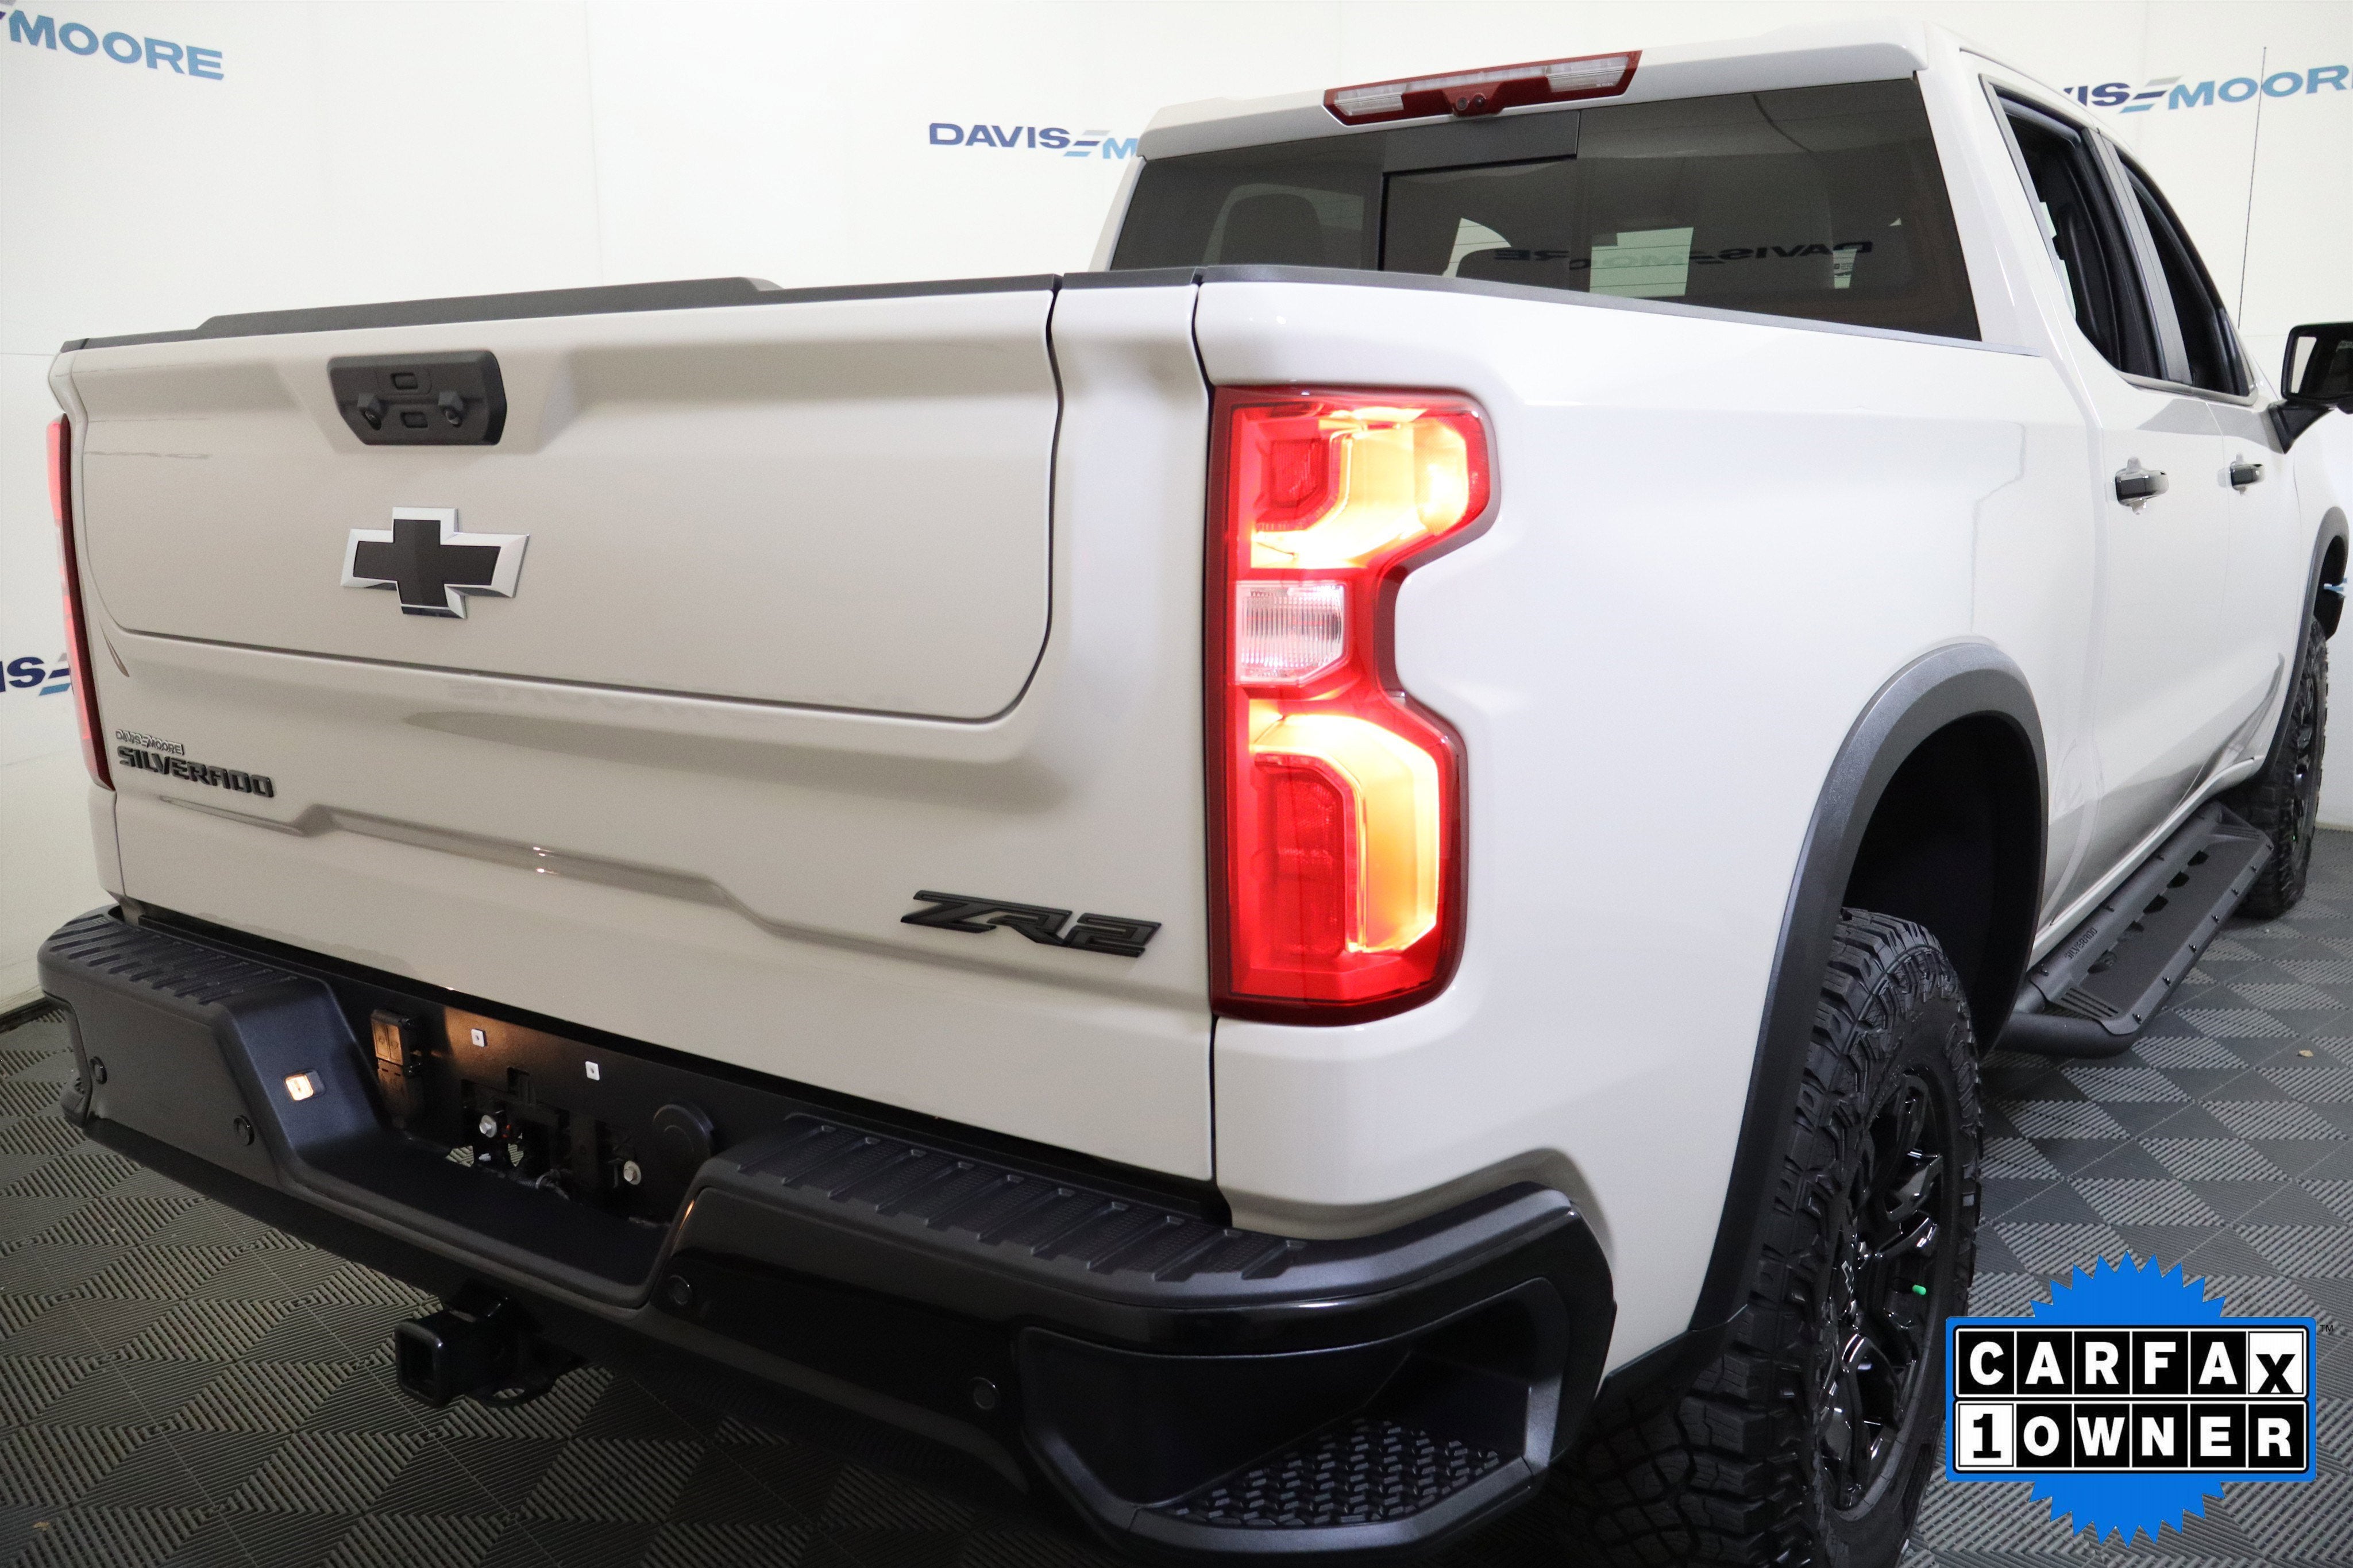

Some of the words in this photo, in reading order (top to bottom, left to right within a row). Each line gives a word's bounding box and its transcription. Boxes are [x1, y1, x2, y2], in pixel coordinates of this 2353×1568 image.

[9, 10, 225, 80] MOORE
[2168, 64, 2353, 110] MOOR
[929, 122, 1071, 149] DAVIS
[115, 729, 142, 745] DAVIS
[146, 736, 184, 756] MOORE
[117, 746, 274, 798] SILVERADO
[901, 890, 1162, 957] ZR2
[2065, 927, 2098, 960] SILVERADO
